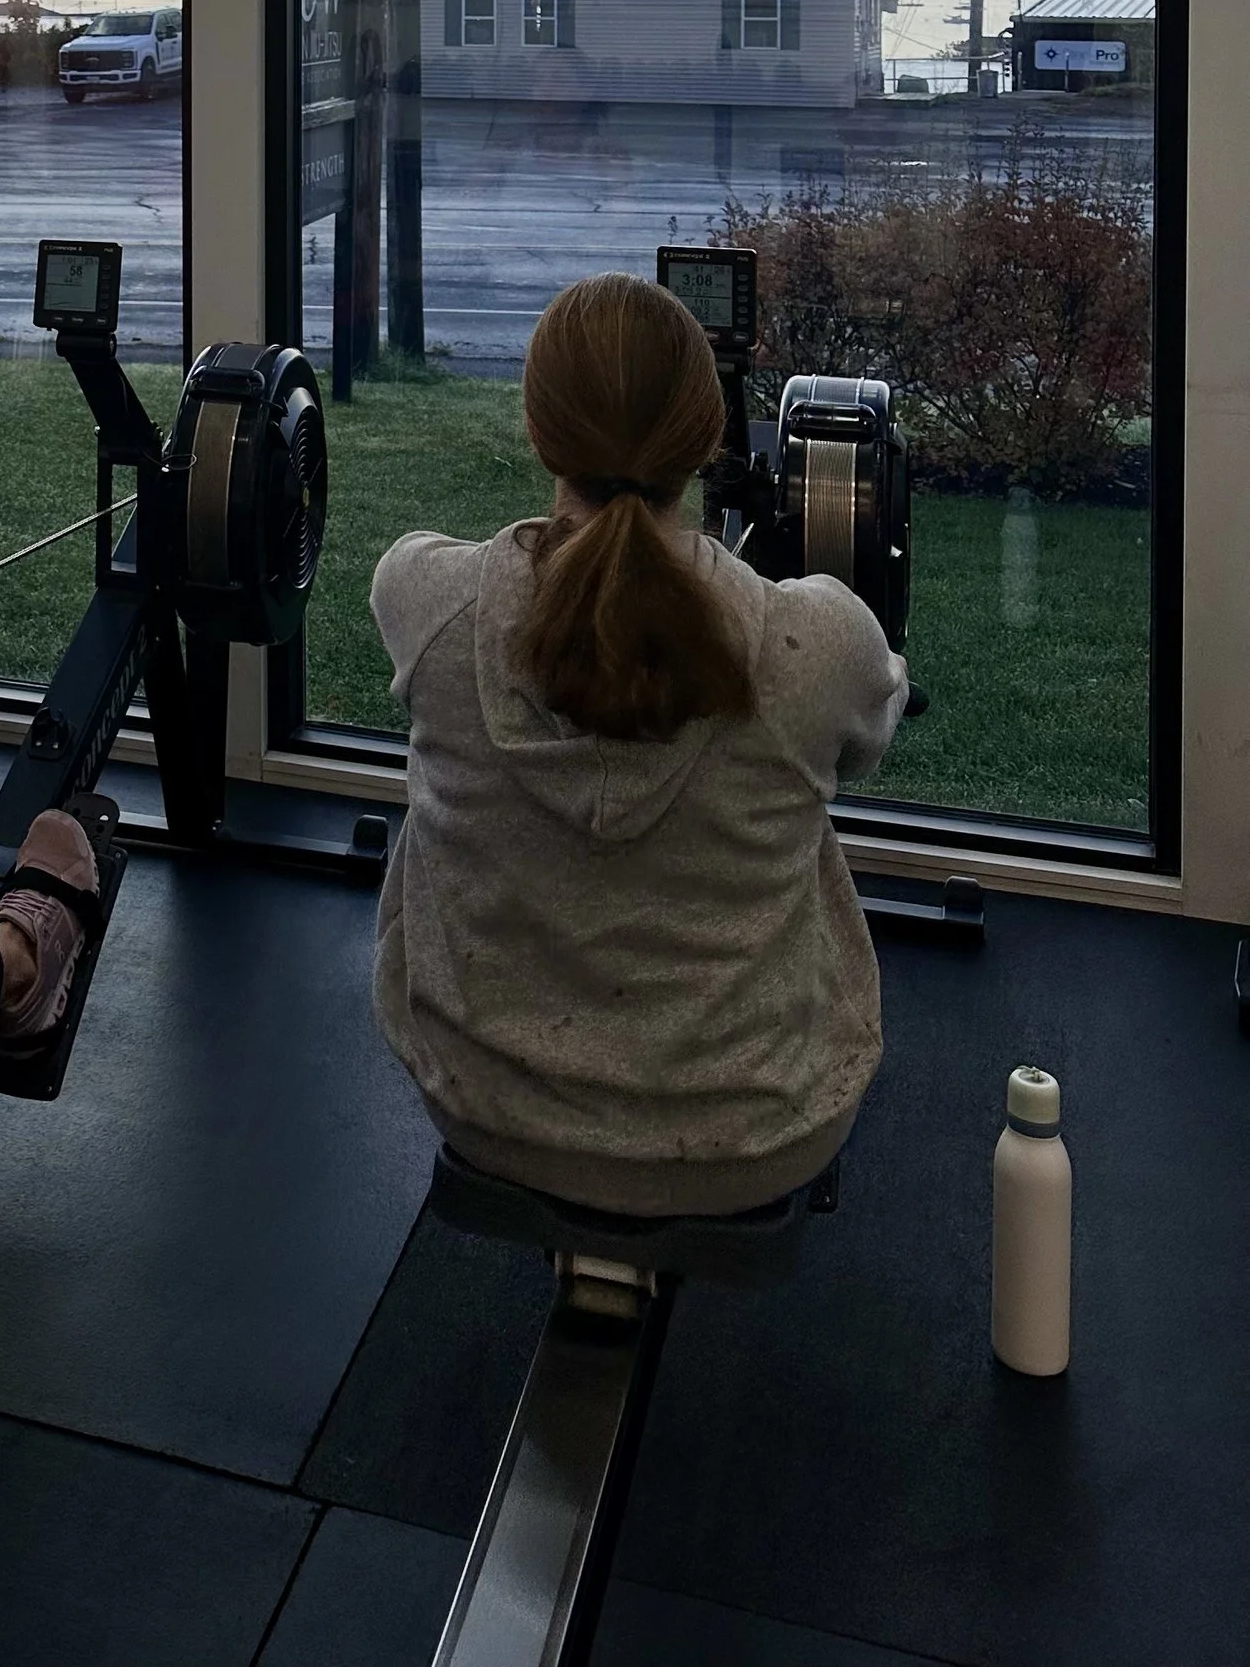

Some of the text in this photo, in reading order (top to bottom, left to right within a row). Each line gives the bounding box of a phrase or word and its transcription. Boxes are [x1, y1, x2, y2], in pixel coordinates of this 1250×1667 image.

[1096, 49, 1119, 61] Pro
[70, 265, 83, 277] 58
[682, 273, 713, 287] 3:08
